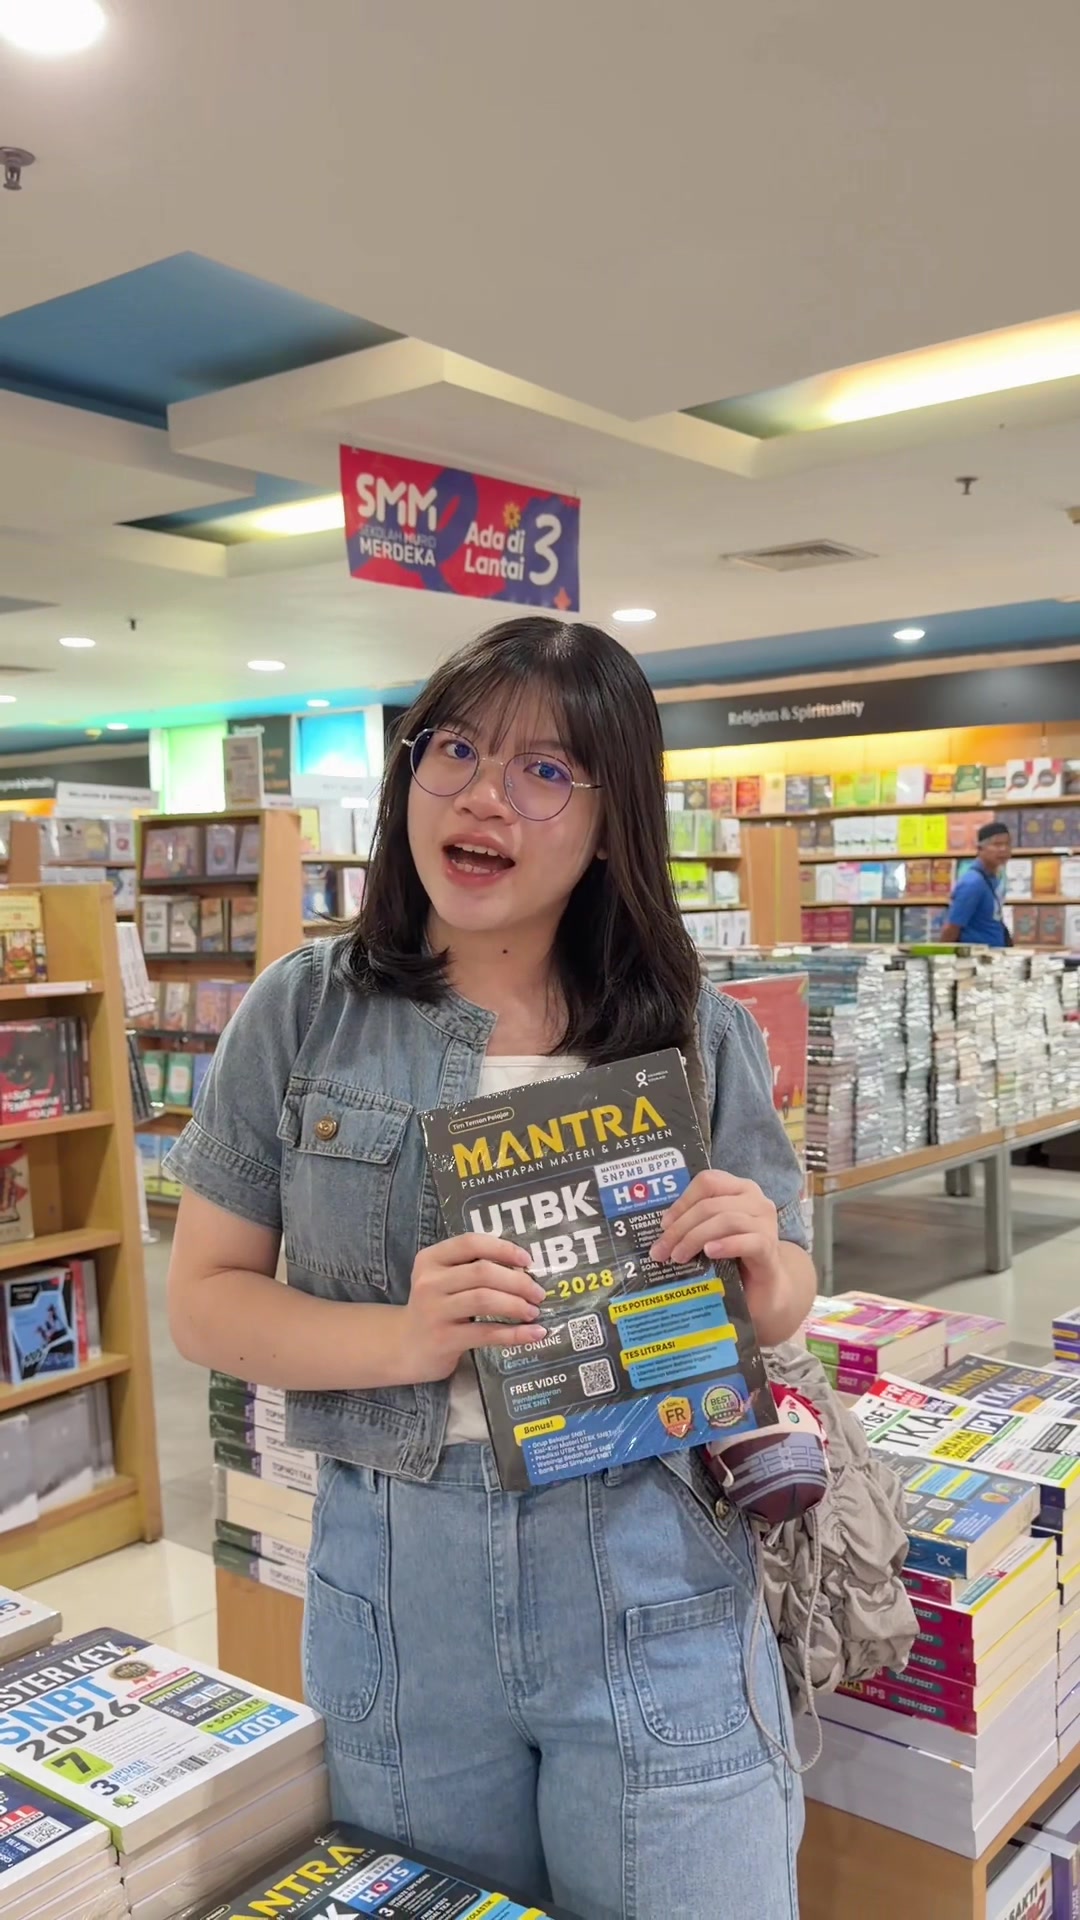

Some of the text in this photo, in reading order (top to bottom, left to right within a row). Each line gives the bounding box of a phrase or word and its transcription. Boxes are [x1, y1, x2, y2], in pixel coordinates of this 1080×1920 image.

[356, 472, 438, 532] SMM
[464, 521, 526, 554] Ada di
[360, 537, 437, 567] MERDEKA
[529, 513, 562, 586] 3
[464, 548, 525, 581] Lantai
[728, 699, 864, 727] Religion & Spirituality
[452, 1123, 465, 1131] Tim
[452, 1095, 667, 1178] MANTRA
[461, 1128, 673, 1189] PEMANTAPAN MATERI & ASESMEN
[600, 1151, 675, 1173] MATERI SESUAI FRAMEWORK
[602, 1158, 678, 1183] SNPMB BPPP
[470, 1180, 599, 1238] UTBK
[629, 1213, 655, 1223] UPDATE
[614, 1221, 627, 1237] 3
[630, 1219, 661, 1230] TERBARU
[526, 1226, 602, 1278] NBT
[624, 1261, 637, 1278] 2
[613, 1283, 709, 1314] TES POTENSI SKOLASTIK
[501, 1335, 562, 1358] OUT ONLINE
[625, 1349, 640, 1359] TES
[640, 1341, 675, 1356] LITERASI
[510, 1373, 567, 1396] FREE VIDEO
[710, 1394, 731, 1406] BEST
[711, 1401, 735, 1411] SELLER
[665, 1407, 686, 1423] FR
[964, 1414, 1010, 1434] IPA
[524, 1420, 553, 1434] Bonus!
[873, 1414, 953, 1447] TKA
[62, 1641, 126, 1673] KEY
[866, 1685, 886, 1700] IPS
[0, 1676, 116, 1745] SNBT
[213, 1704, 245, 1724] SOAL
[245, 1697, 264, 1710] FR
[16, 1699, 141, 1761] 2026
[51, 1751, 92, 1774] 7
[108, 1759, 147, 1781] UPDATE
[90, 1779, 120, 1796] 3
[287, 1888, 323, 1913] MATERI
[335, 1848, 376, 1880] ASESMEN
[378, 1907, 395, 1917] 3
